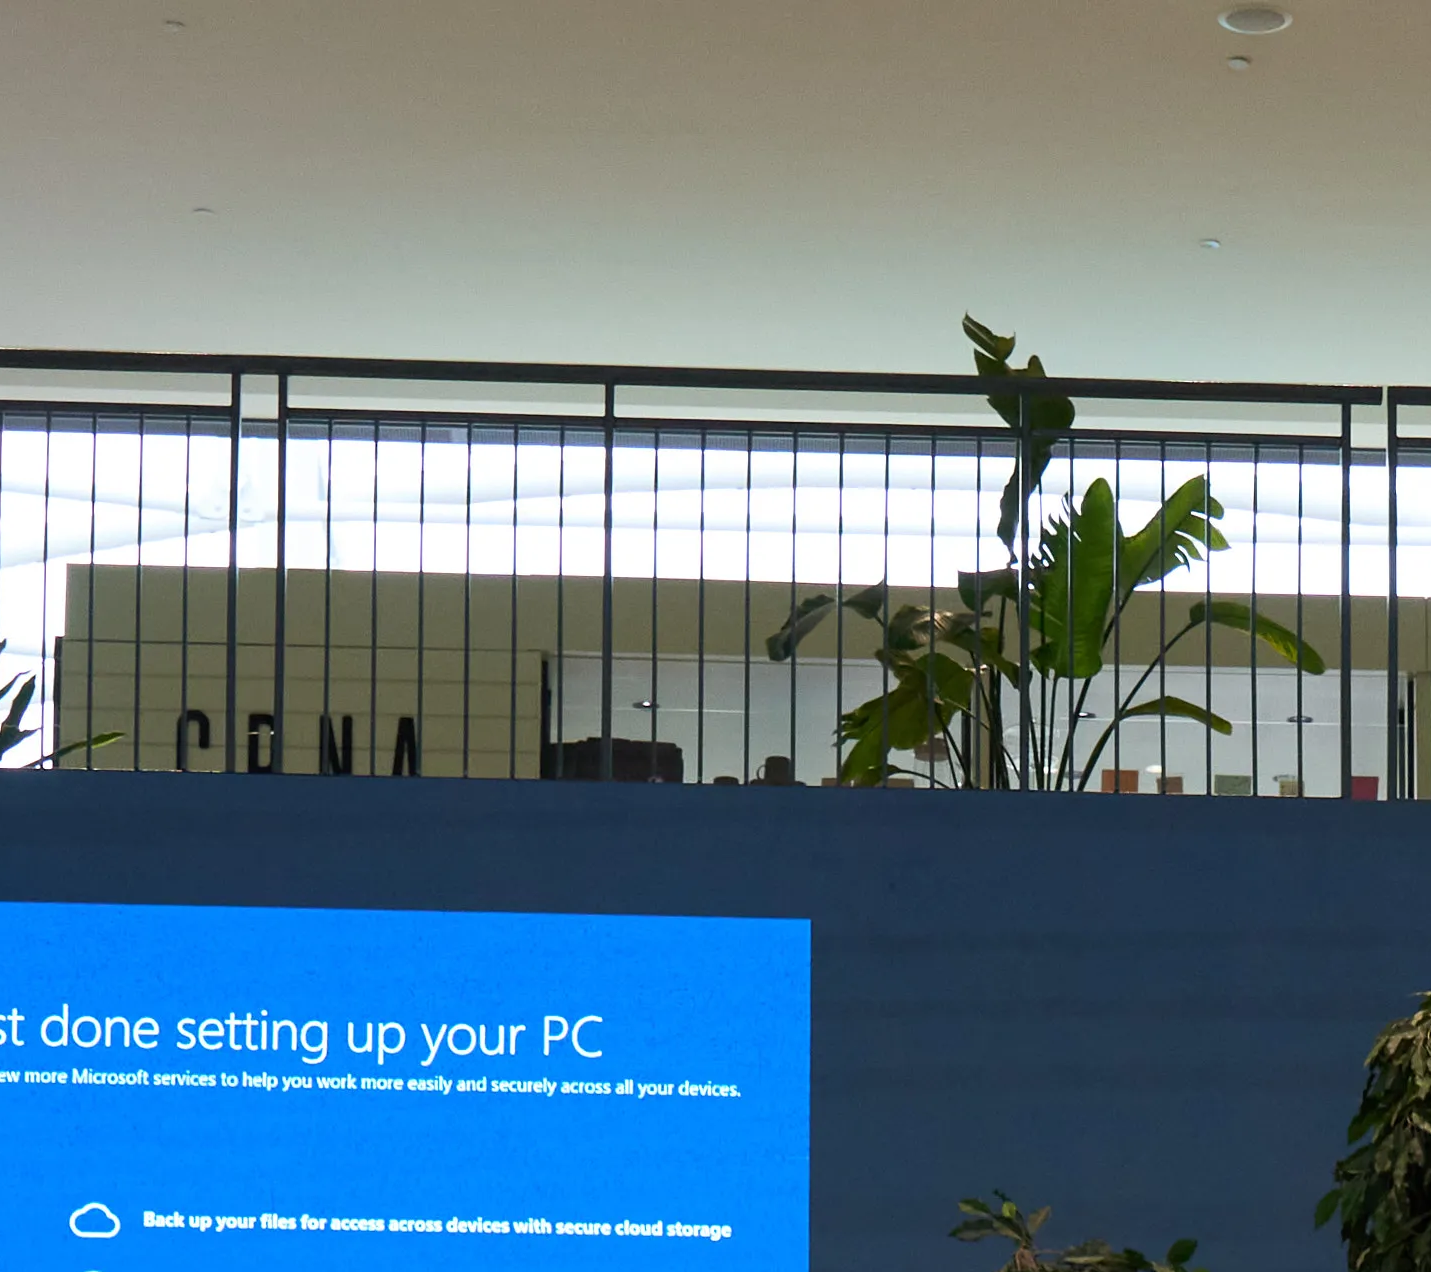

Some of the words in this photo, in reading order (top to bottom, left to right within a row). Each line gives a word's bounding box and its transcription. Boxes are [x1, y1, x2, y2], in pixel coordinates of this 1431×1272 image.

[40, 1003, 160, 1050] done
[176, 1009, 329, 1065] setting
[347, 1021, 406, 1066] up
[420, 1023, 527, 1067] your
[543, 1015, 603, 1059] PC
[24, 1071, 68, 1084] more
[71, 1067, 150, 1086] Microsoft
[153, 1070, 217, 1087] services
[220, 1072, 239, 1088] to
[242, 1071, 279, 1092] help
[281, 1076, 313, 1092] you
[316, 1073, 358, 1090] work
[360, 1077, 405, 1091] more
[406, 1075, 453, 1095] easily
[456, 1076, 487, 1092] and
[491, 1077, 558, 1097] securely
[560, 1081, 612, 1095] across
[615, 1079, 634, 1095] all
[637, 1083, 675, 1099] your
[677, 1080, 741, 1097] devices.
[143, 1210, 186, 1228] Back
[188, 1215, 213, 1232] up
[215, 1215, 257, 1233] your
[259, 1213, 298, 1230] files
[299, 1213, 328, 1231] for
[329, 1217, 386, 1232] access
[388, 1219, 443, 1233] across
[445, 1216, 511, 1234] devices
[512, 1217, 553, 1235] with
[555, 1221, 612, 1236] secure
[614, 1219, 664, 1237] cloud
[666, 1221, 733, 1242] storage
